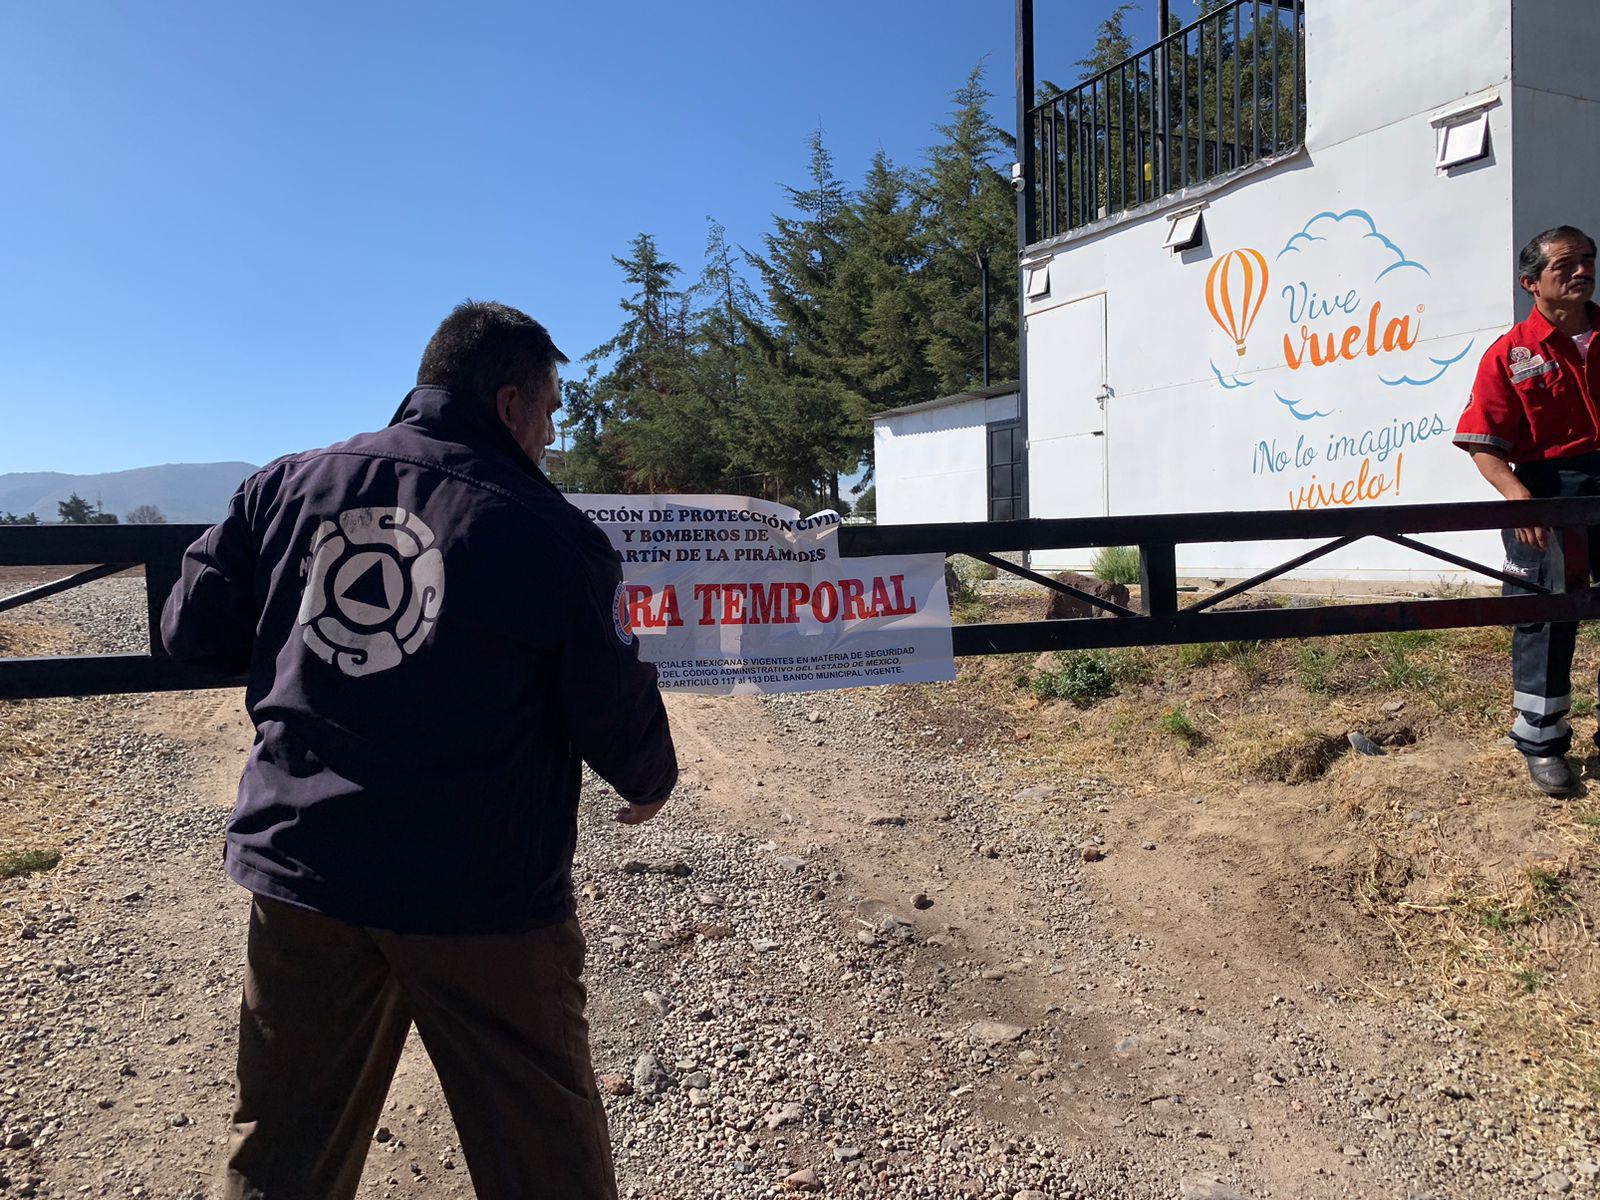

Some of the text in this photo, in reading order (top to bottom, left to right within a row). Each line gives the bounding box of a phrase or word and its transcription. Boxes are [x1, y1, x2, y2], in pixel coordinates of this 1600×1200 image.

[1281, 281, 1361, 324] Vive
[1283, 300, 1421, 370] vuela
[1294, 434, 1318, 469] lo
[1325, 413, 1452, 463] imagines
[647, 508, 675, 522] DE
[678, 508, 793, 532] PROTECCIÓN
[796, 512, 840, 531] CIVIL
[621, 528, 769, 543] Y BOMBEROS DE
[675, 549, 701, 562] DE
[705, 548, 730, 562] LA
[734, 545, 826, 563] PIRÁMIDES
[693, 574, 917, 627] TEMPORAL
[695, 658, 748, 668] MEXICANAS
[750, 656, 795, 666] VIGENTES
[796, 656, 809, 665] EN
[810, 652, 849, 663] MATERIA
[850, 651, 863, 660] DE
[864, 646, 915, 658] SEGURIDAD
[662, 670, 681, 679] DEL
[720, 665, 793, 676] ADMINISTRATIVO
[815, 662, 850, 671] ESTADO
[852, 660, 864, 668] DE
[672, 677, 719, 688] ARTÍCULO
[721, 676, 735, 685] 117
[748, 675, 762, 684] 133
[763, 674, 781, 683] DEL
[783, 672, 814, 682] BANDO
[816, 670, 863, 680] MUNICIPAL
[864, 666, 904, 677] VIGENTE.
